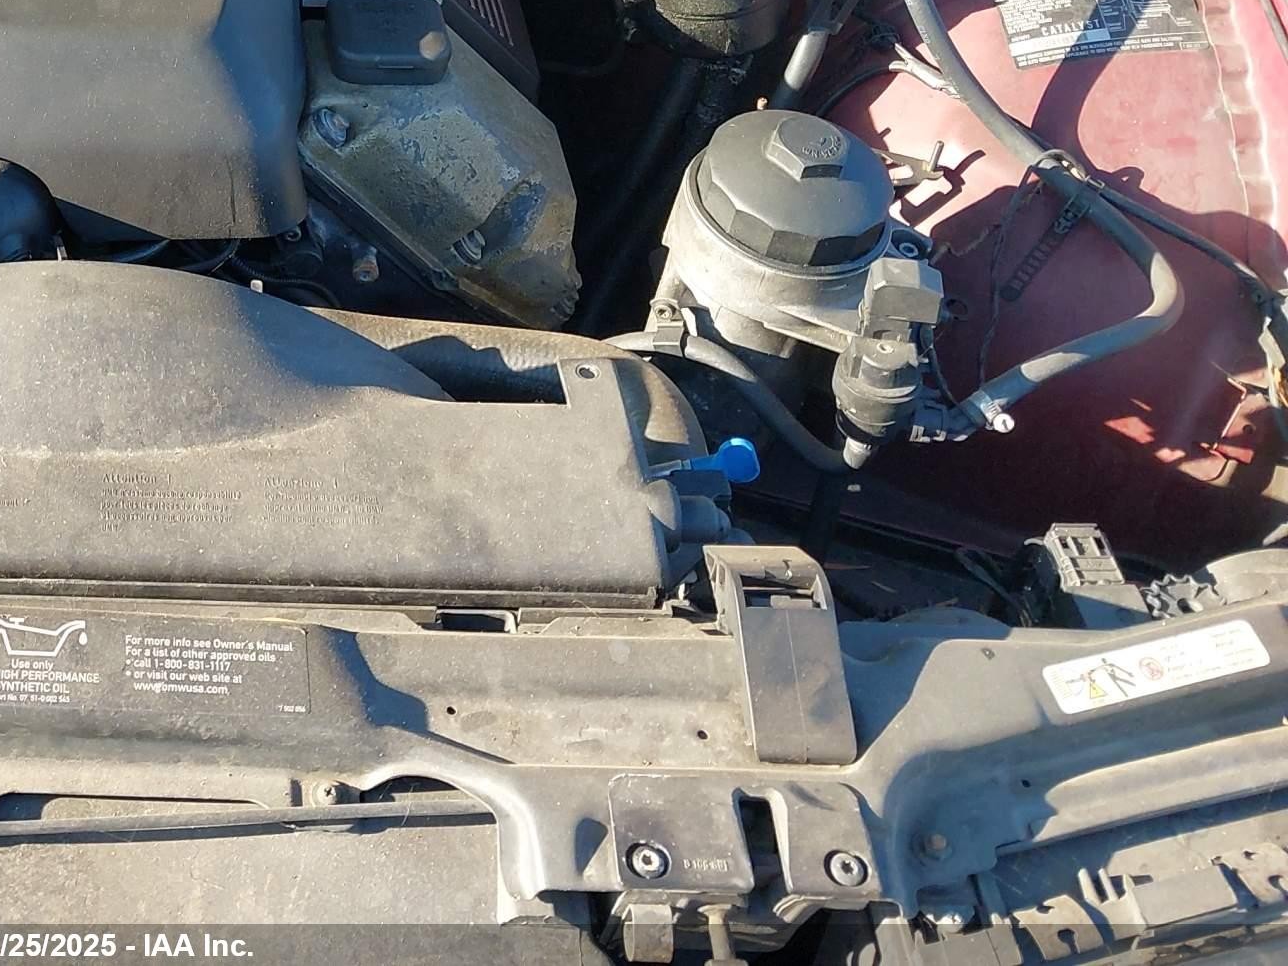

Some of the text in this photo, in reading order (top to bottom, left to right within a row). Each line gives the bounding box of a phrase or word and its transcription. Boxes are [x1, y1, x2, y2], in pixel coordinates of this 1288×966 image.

[1041, 19, 1101, 36] CATALYST
[125, 635, 293, 652] For more info see Owner's Manual
[125, 646, 276, 664] For a list of other approved oils
[11, 659, 54, 672] Use only
[133, 659, 231, 671] call 1-800-831-1117
[21, 671, 100, 683] PERFORMANCE
[134, 671, 243, 684] or visit our web site at
[53, 683, 70, 694] OIL
[133, 682, 229, 695] wwwbmwusa.com
